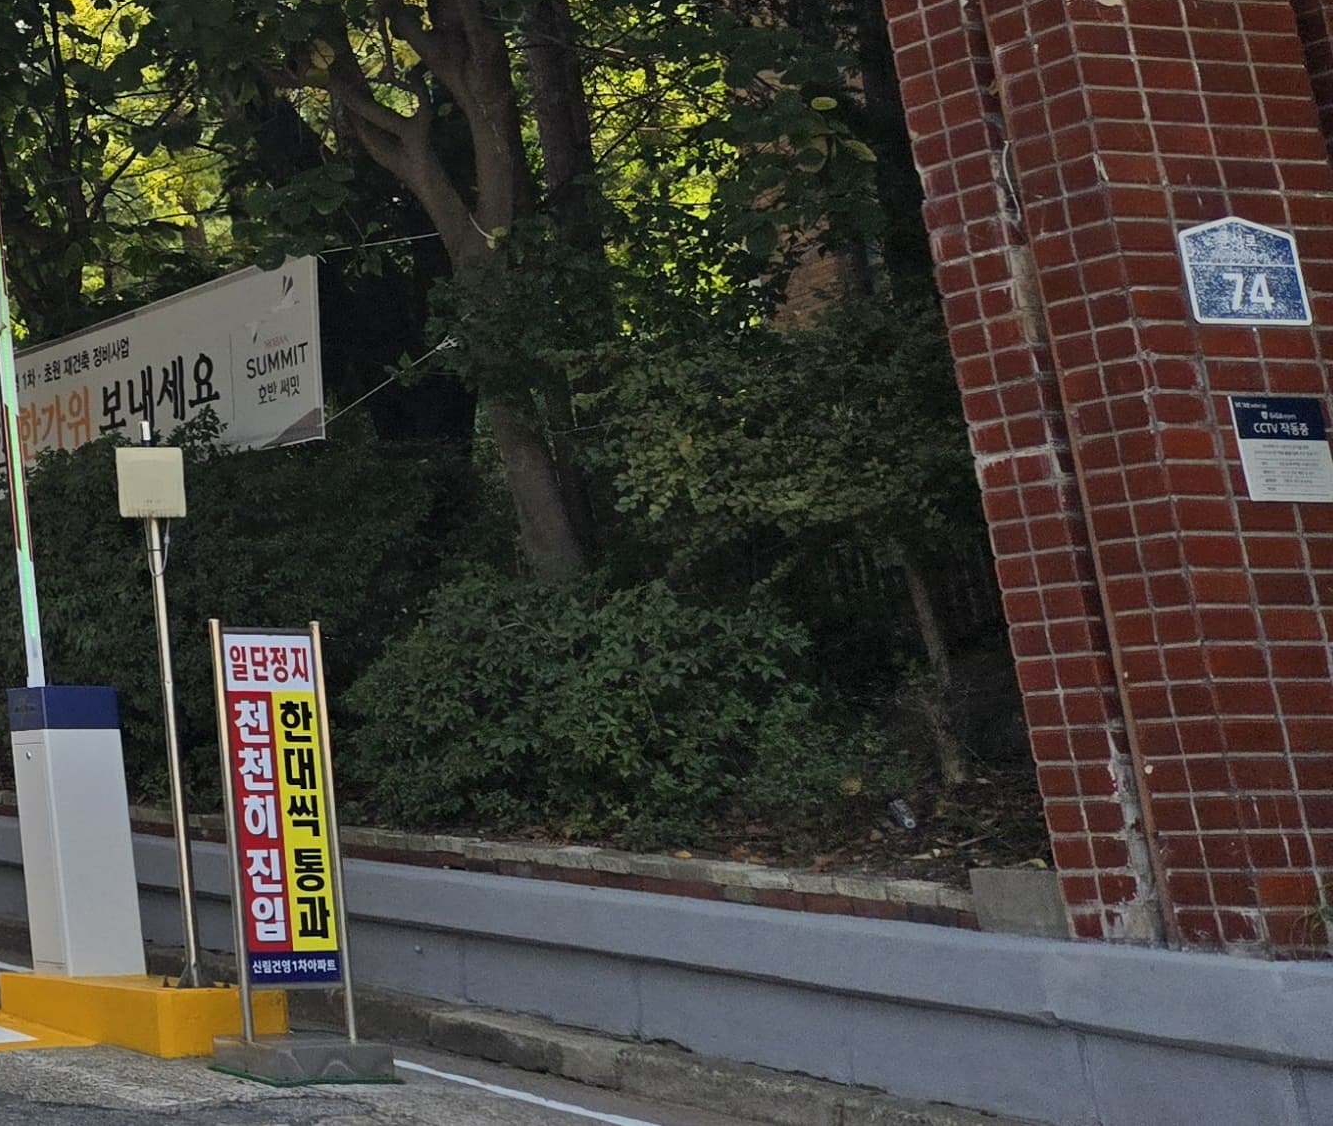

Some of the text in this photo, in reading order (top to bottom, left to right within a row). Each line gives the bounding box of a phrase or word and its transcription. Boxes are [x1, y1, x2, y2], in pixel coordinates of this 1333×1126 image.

[1222, 272, 1276, 311] 74
[44, 359, 62, 383] 초원
[63, 349, 90, 375] 재건축
[93, 336, 130, 368] 정비사업
[246, 341, 309, 380] SUMMIT
[99, 352, 221, 433] 보내세요
[258, 383, 278, 405] 호반
[1253, 422, 1309, 436] CCTV 작동중
[229, 644, 310, 684] 일단정지
[234, 699, 286, 943] 천천히 진입
[279, 700, 331, 941] 한대씩 통과
[252, 959, 337, 974] 신림건영1차아파트
